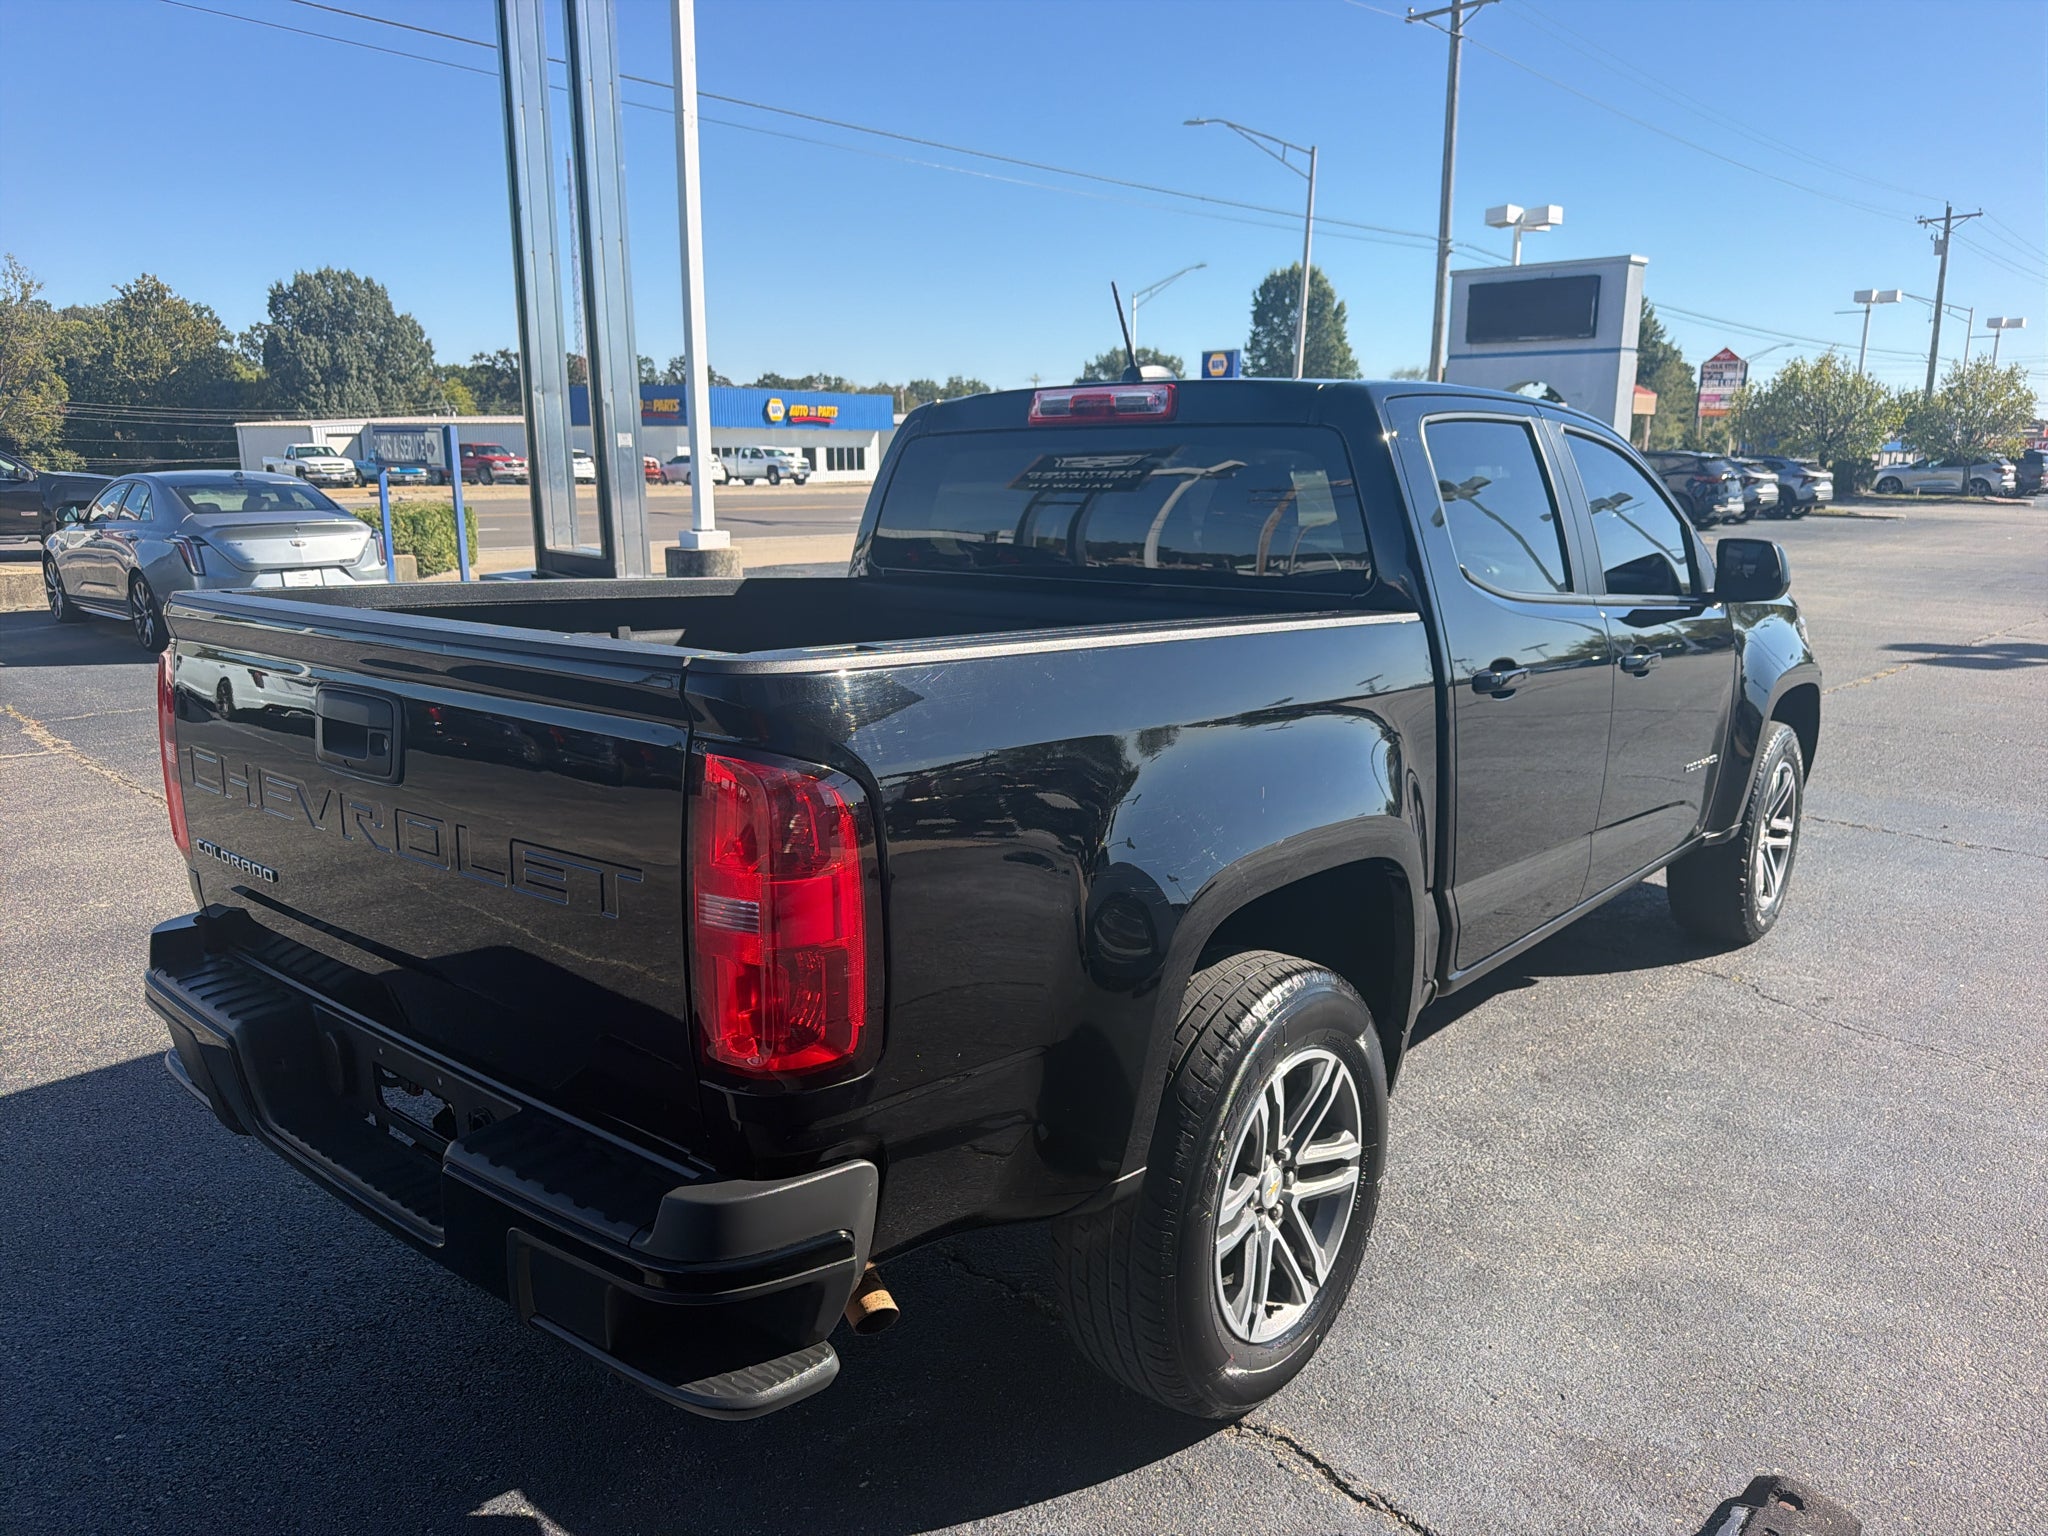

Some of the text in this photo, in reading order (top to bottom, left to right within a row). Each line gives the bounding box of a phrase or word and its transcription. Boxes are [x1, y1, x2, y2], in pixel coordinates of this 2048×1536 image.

[653, 398, 680, 412] PARTS
[789, 404, 809, 417] AUTO
[817, 405, 838, 418] PARTS
[399, 434, 426, 460] SERVICE
[190, 744, 644, 918] CHEVROLET
[196, 838, 277, 883] COLORADO
